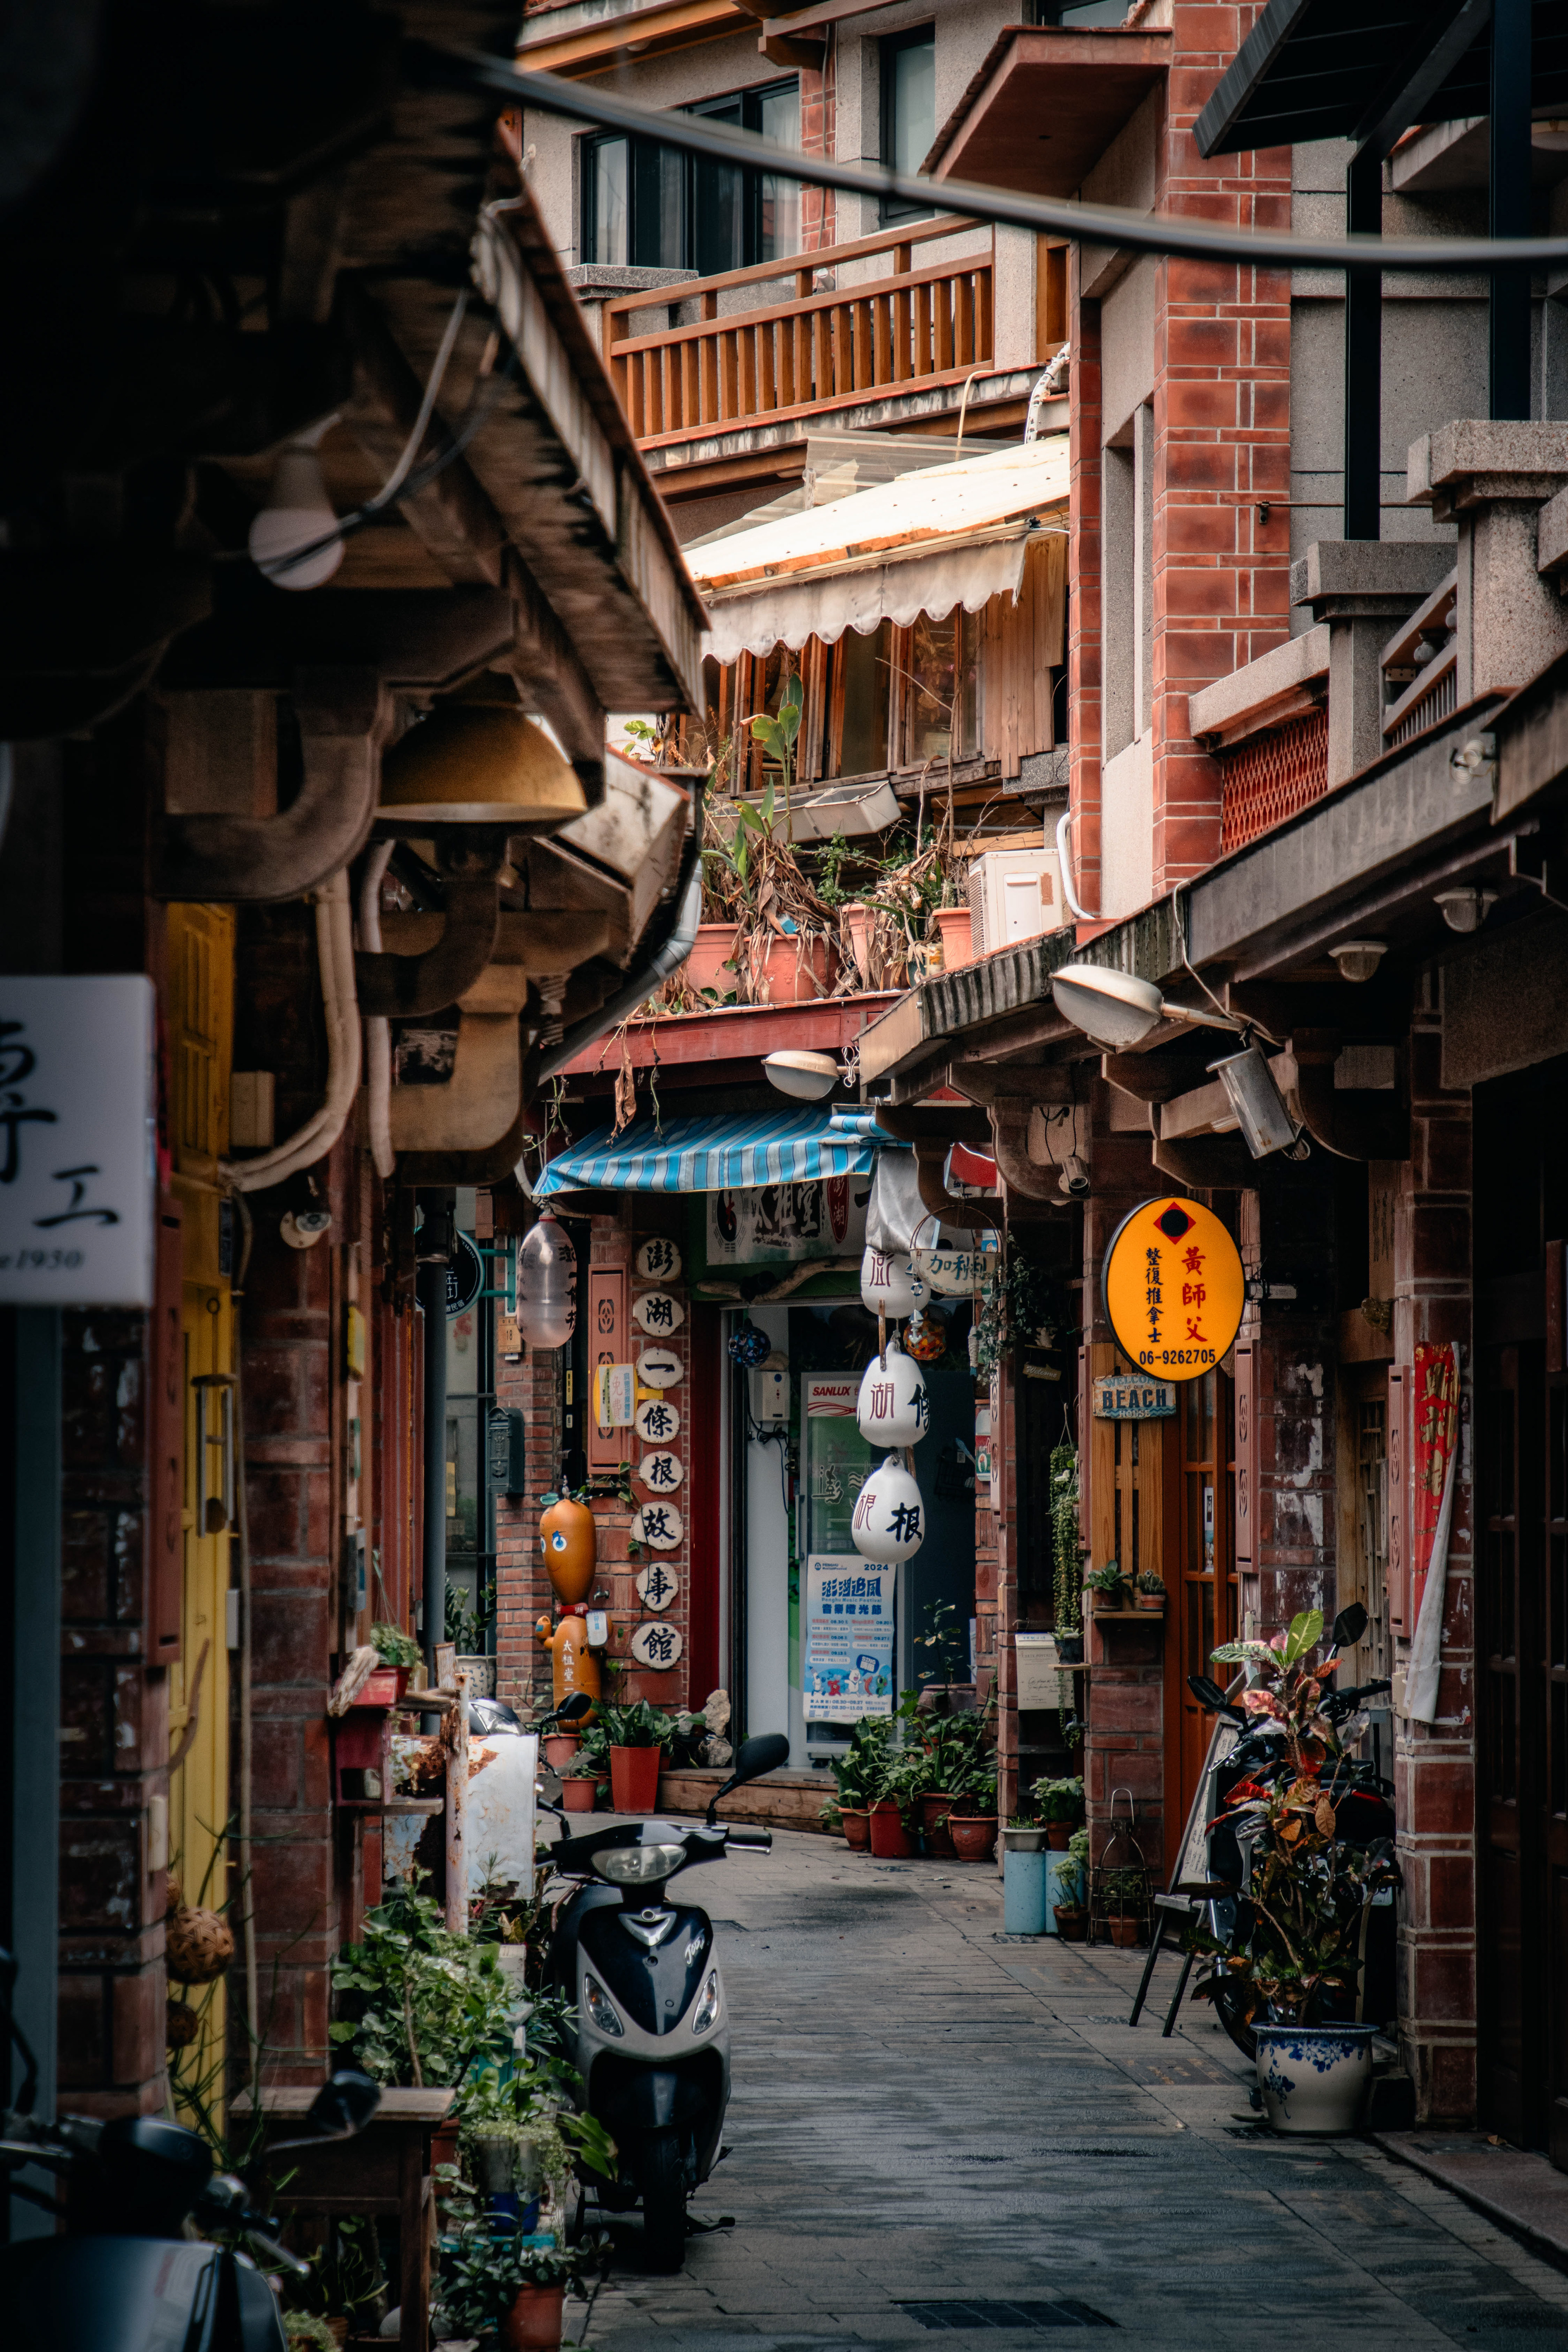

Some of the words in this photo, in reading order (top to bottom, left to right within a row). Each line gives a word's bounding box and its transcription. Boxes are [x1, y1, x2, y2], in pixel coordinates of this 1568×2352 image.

[1145, 1247, 1164, 1343] 整復推拿士
[1181, 1246, 1207, 1342] 黃師父
[506, 1330, 512, 1341] 18
[1139, 1349, 1216, 1364] 06-9262705
[1026, 1366, 1057, 1378] Welcome
[1104, 1375, 1156, 1388] WELCOM
[812, 1386, 851, 1396] SANLUX
[869, 1383, 894, 1420] 湖
[1102, 1388, 1166, 1409] BEACH
[1119, 1410, 1151, 1419] HOUSE
[642, 1241, 681, 1662] 澎湖一條根故事館
[885, 1502, 922, 1544] 根
[822, 1576, 882, 1597] 澎湖追風
